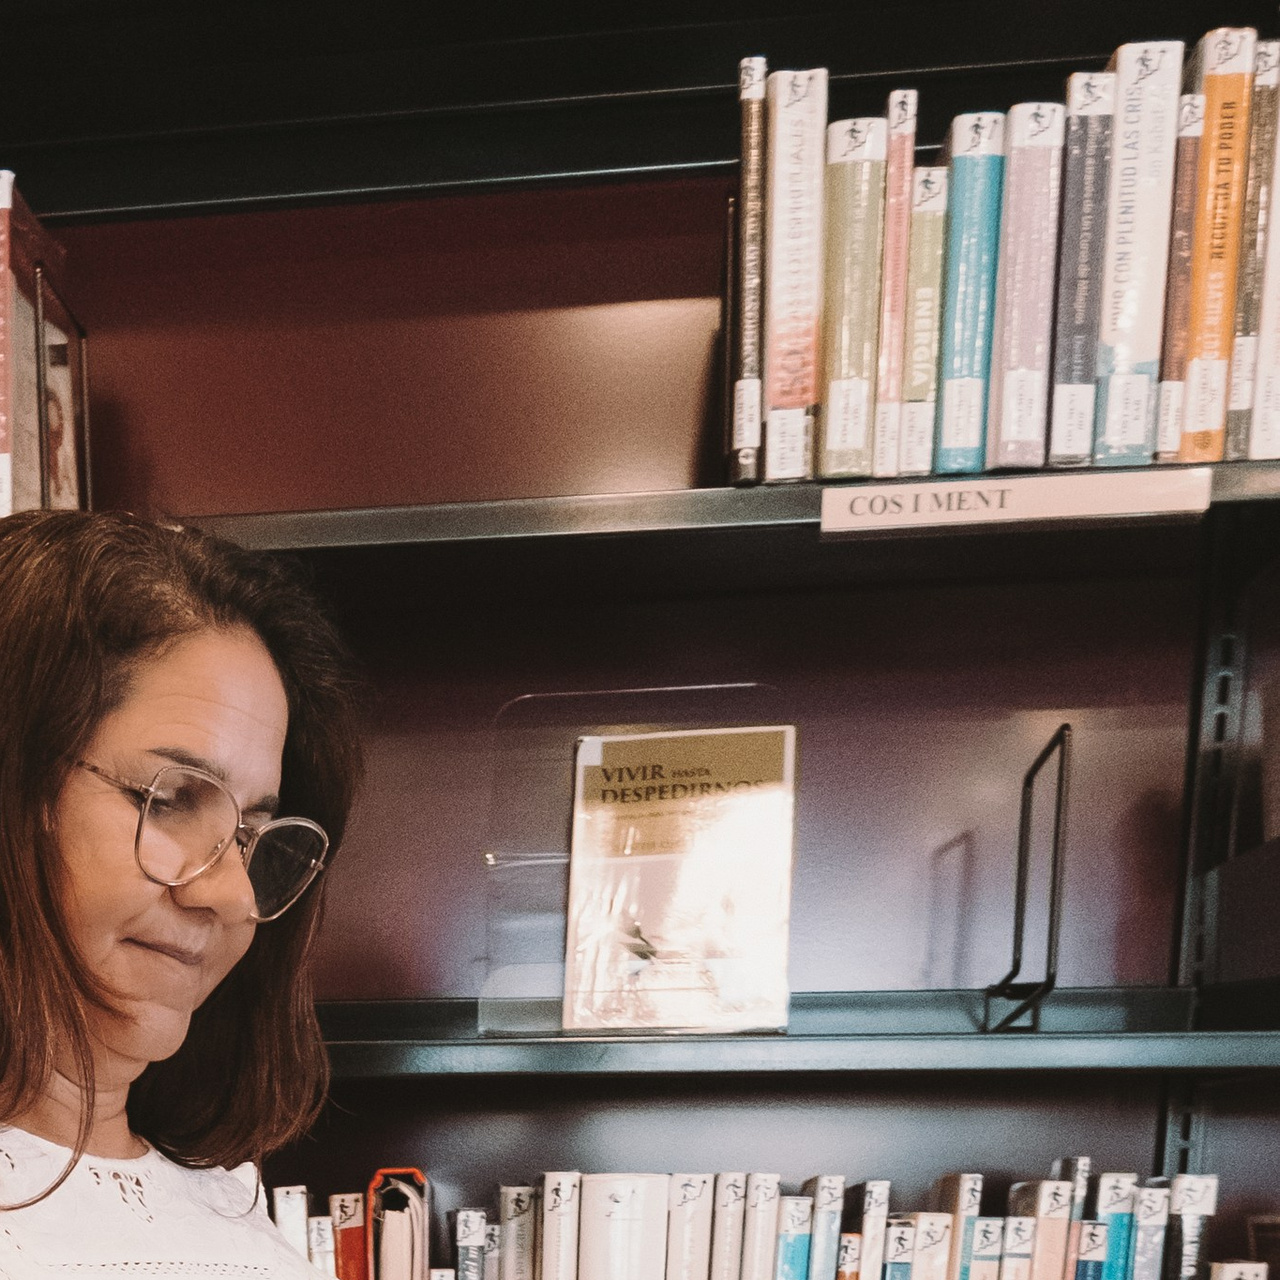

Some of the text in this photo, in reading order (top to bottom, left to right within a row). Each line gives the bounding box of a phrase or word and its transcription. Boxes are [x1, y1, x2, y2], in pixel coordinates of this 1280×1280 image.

[1113, 127, 1141, 284] CON PLENITUD LAS
[1209, 99, 1236, 259] RECUPERA TU PODER
[847, 488, 1013, 518] COS I MENT
[600, 764, 665, 784] VIVIR
